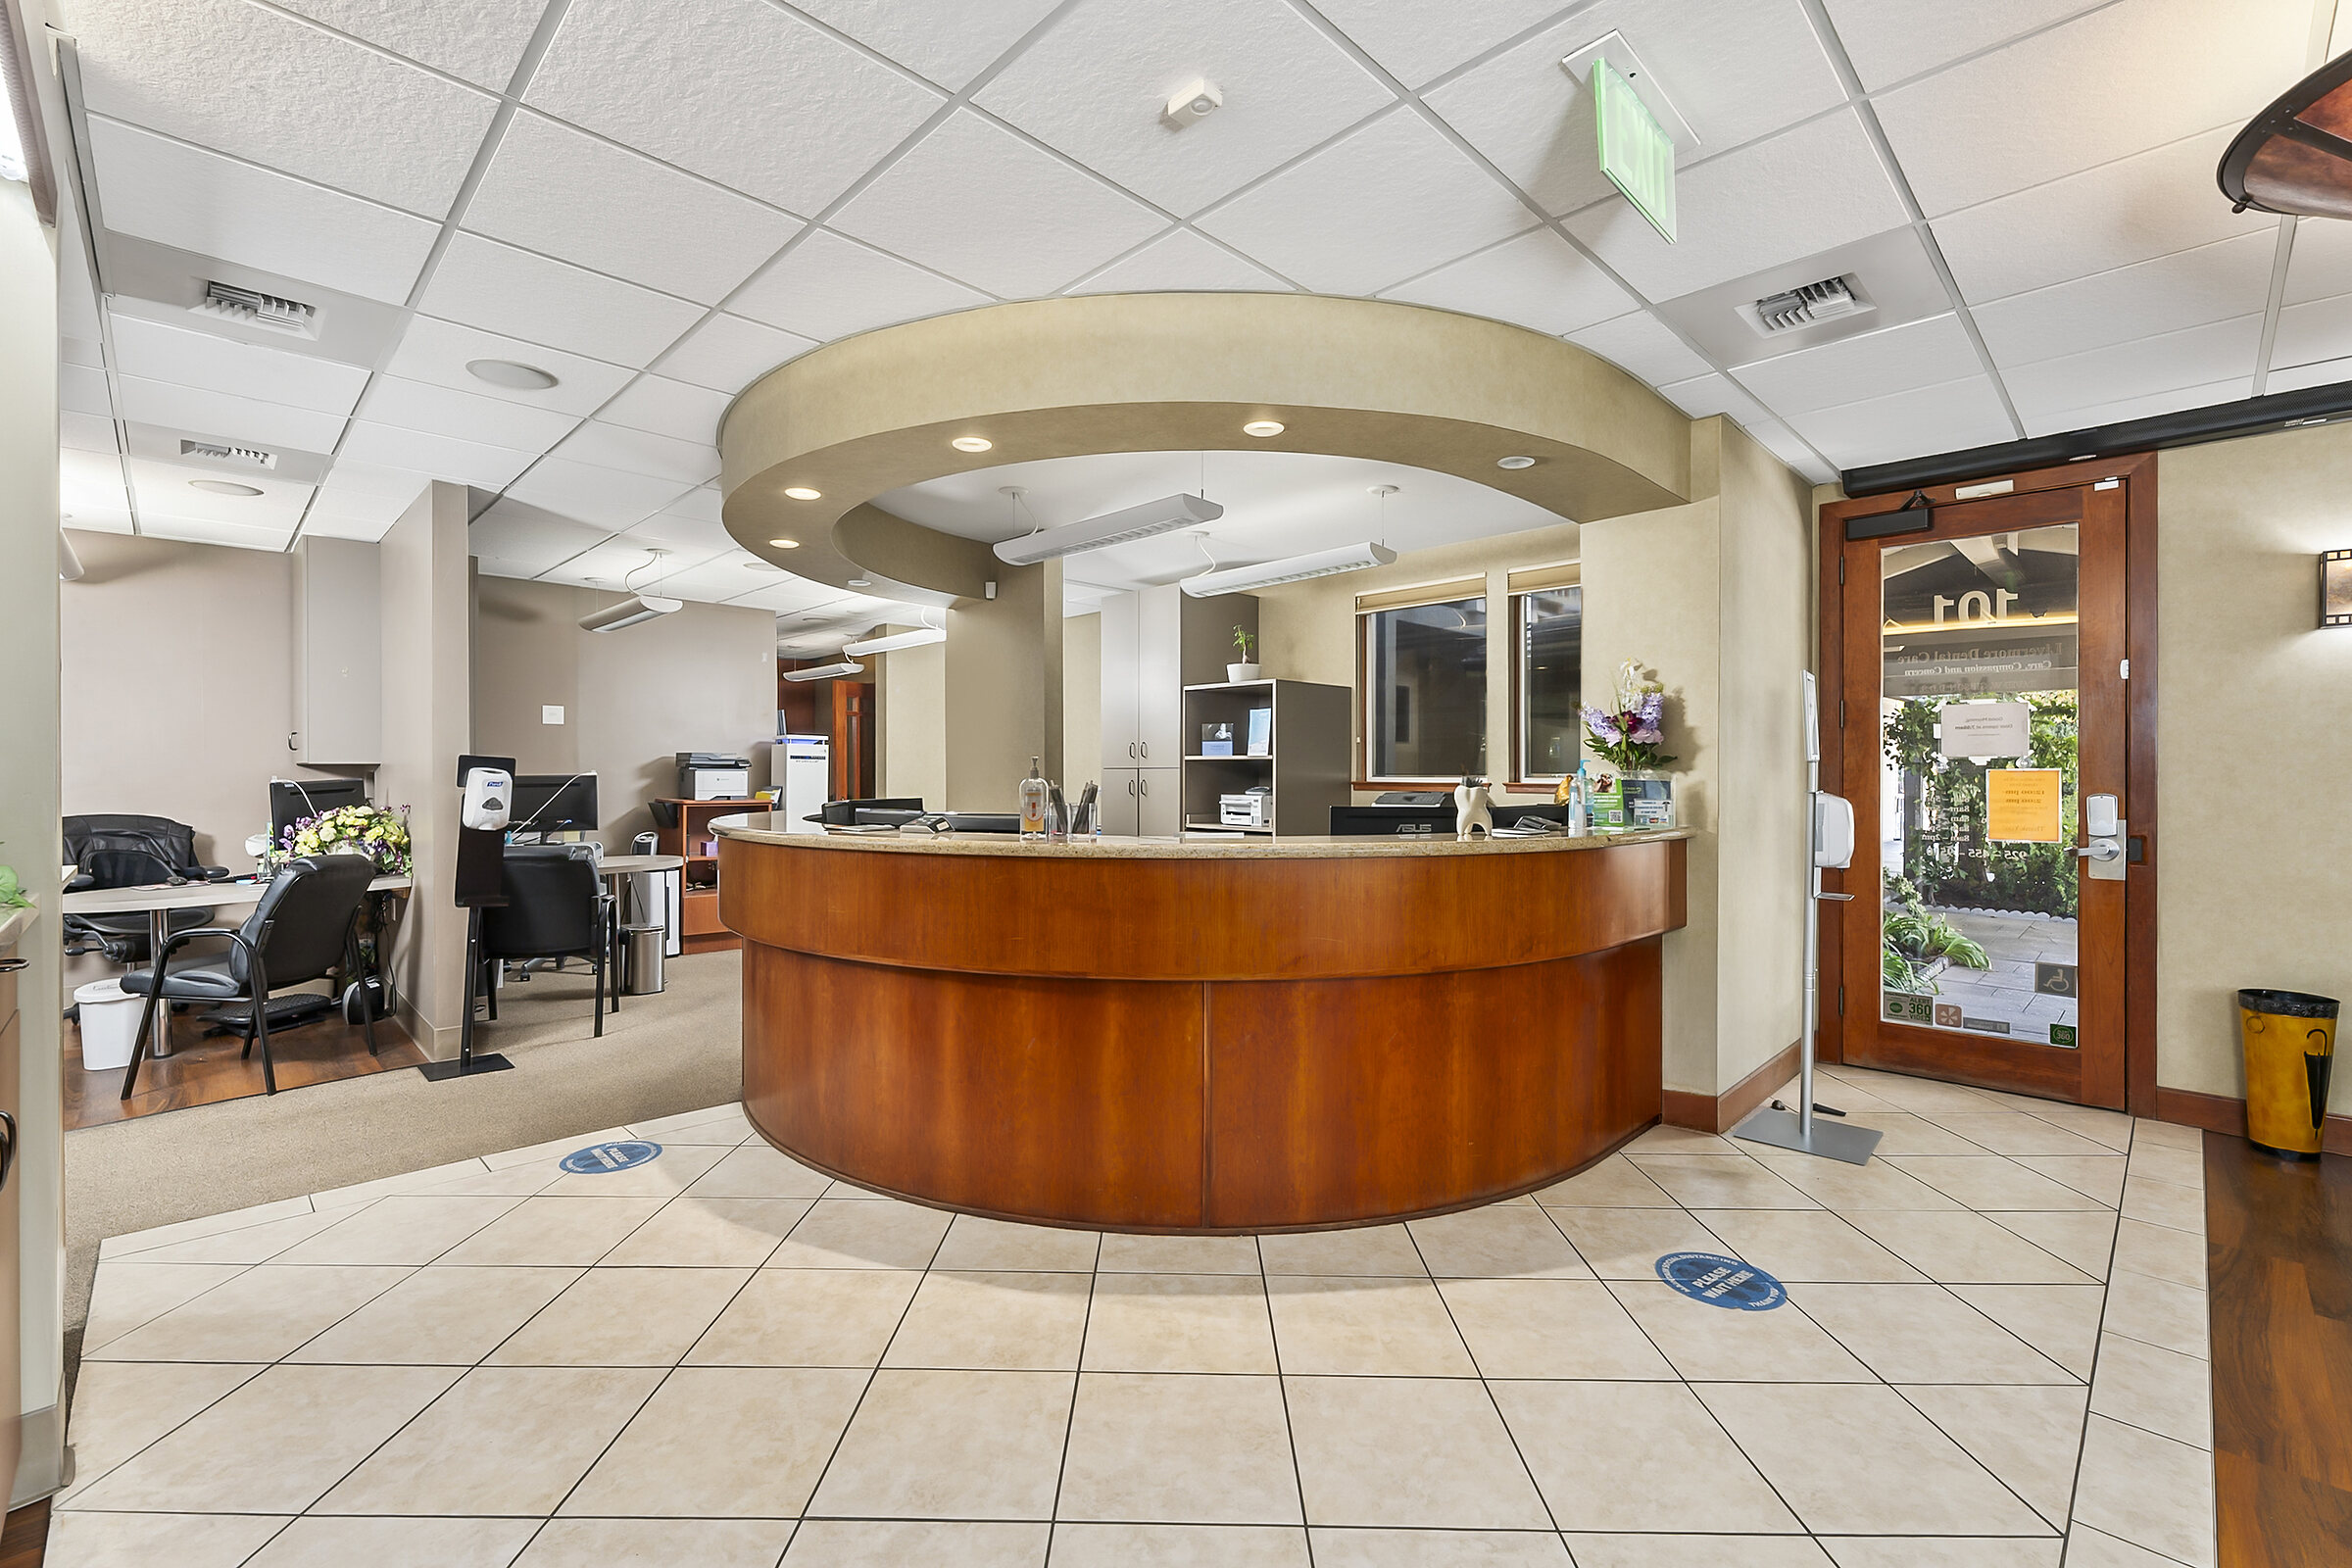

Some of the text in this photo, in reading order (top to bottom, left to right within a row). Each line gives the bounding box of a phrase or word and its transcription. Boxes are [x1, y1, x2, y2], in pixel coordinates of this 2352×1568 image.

[1396, 823, 1432, 833] ASUS
[1908, 1003, 1932, 1016] 360
[1691, 1266, 1733, 1289] PLEASE
[1701, 1270, 1755, 1298] WAIT HERE
